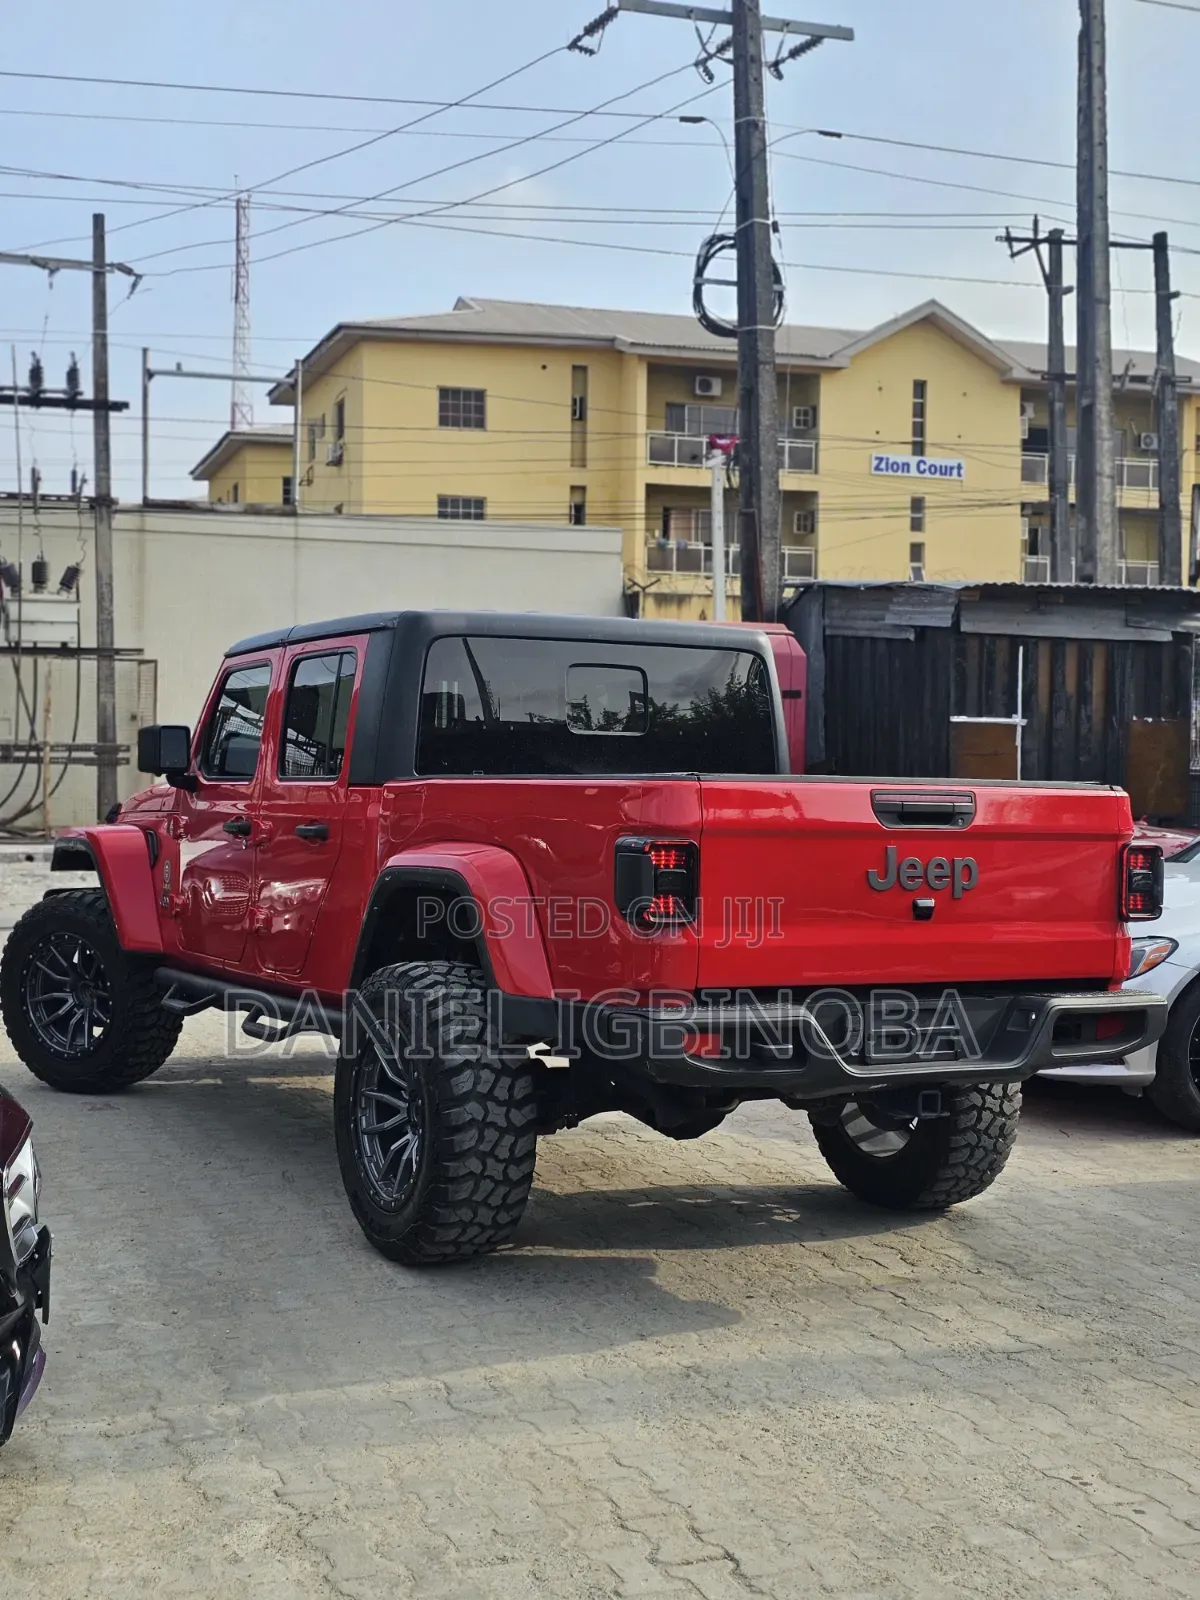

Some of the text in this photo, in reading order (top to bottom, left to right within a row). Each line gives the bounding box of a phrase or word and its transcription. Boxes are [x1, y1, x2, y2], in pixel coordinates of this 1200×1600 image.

[873, 456, 963, 477] Zion Court
[867, 845, 978, 899] Jeep
